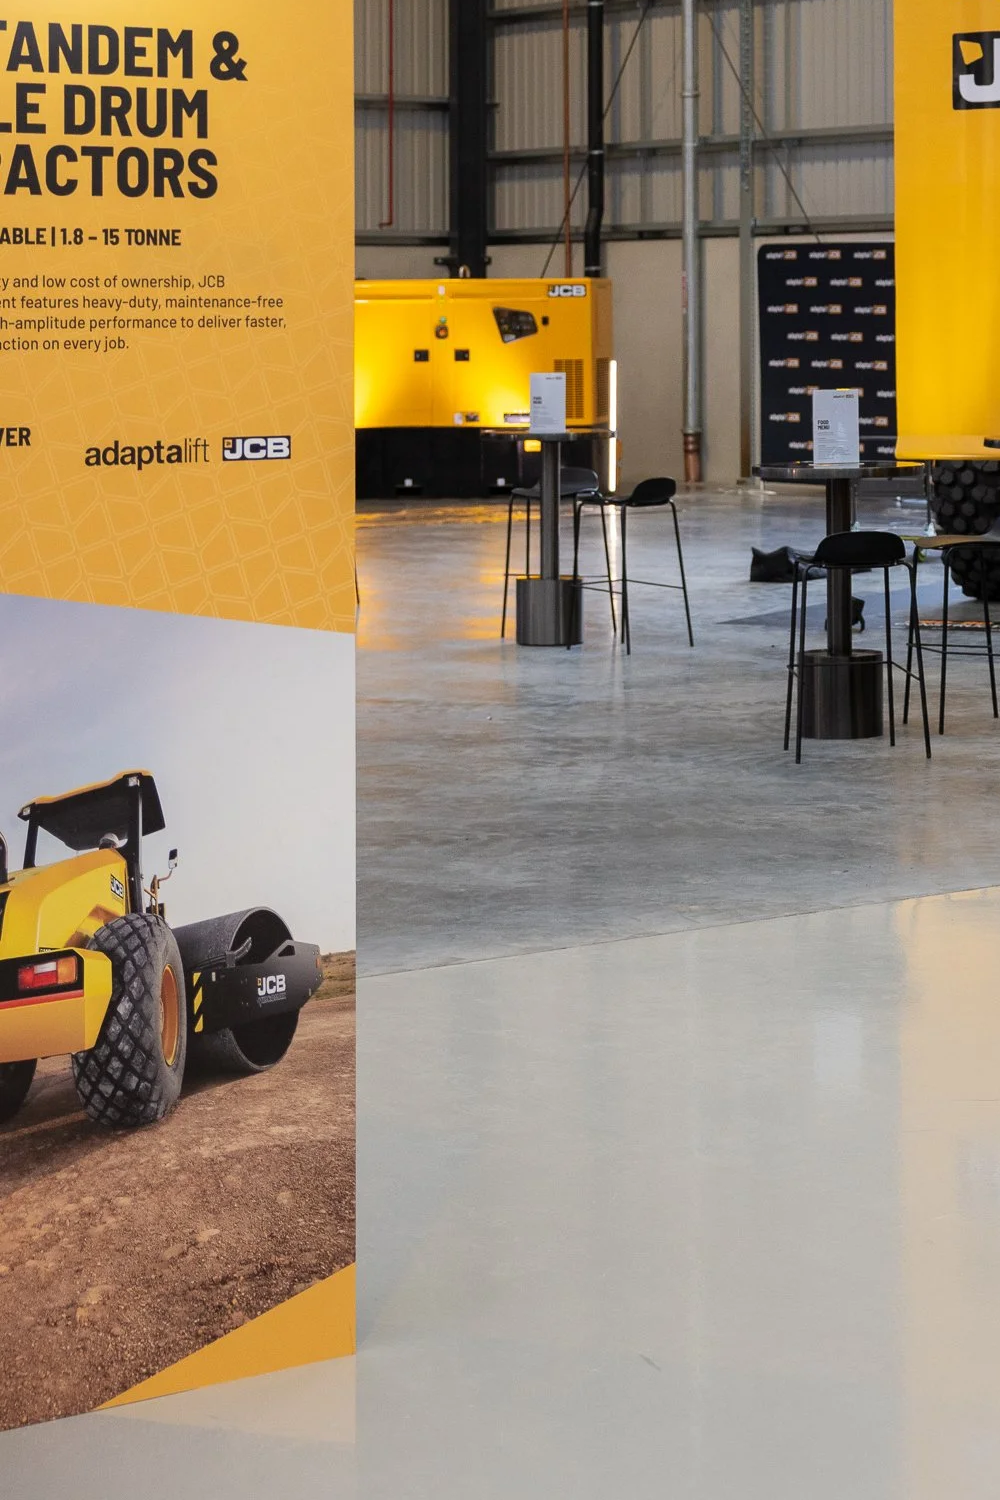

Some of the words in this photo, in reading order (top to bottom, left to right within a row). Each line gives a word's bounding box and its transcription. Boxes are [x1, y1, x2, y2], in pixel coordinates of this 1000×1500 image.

[0, 20, 193, 79] ANDEM
[210, 31, 248, 81] &
[64, 84, 208, 139] DRUM
[1, 144, 218, 199] ACTORS
[0, 227, 47, 245] ABLE
[61, 228, 83, 245] 1.8
[102, 228, 119, 246] 15
[125, 229, 181, 246] TONNE
[0, 277, 9, 291] y
[13, 275, 39, 288] and
[42, 275, 66, 288] low
[70, 276, 100, 288] cost
[104, 275, 117, 288] of
[121, 275, 195, 291] ownership,
[198, 275, 225, 288] JCB
[549, 285, 586, 296] JCB
[0, 297, 16, 309] nt
[21, 296, 79, 309] features
[82, 296, 161, 311] heavy-duty,
[165, 295, 284, 309] maintenance-free
[0, 316, 85, 332] h-amplitude
[89, 316, 177, 332] performance
[180, 316, 194, 329] to
[197, 315, 241, 328] deliver
[245, 315, 286, 329] faster,
[0, 337, 38, 350] ction
[42, 340, 59, 350] on
[63, 339, 101, 352] every
[104, 337, 129, 352] job.
[85, 437, 210, 470] adaptalift
[223, 437, 291, 461] JCB
[257, 974, 287, 997] JCB
